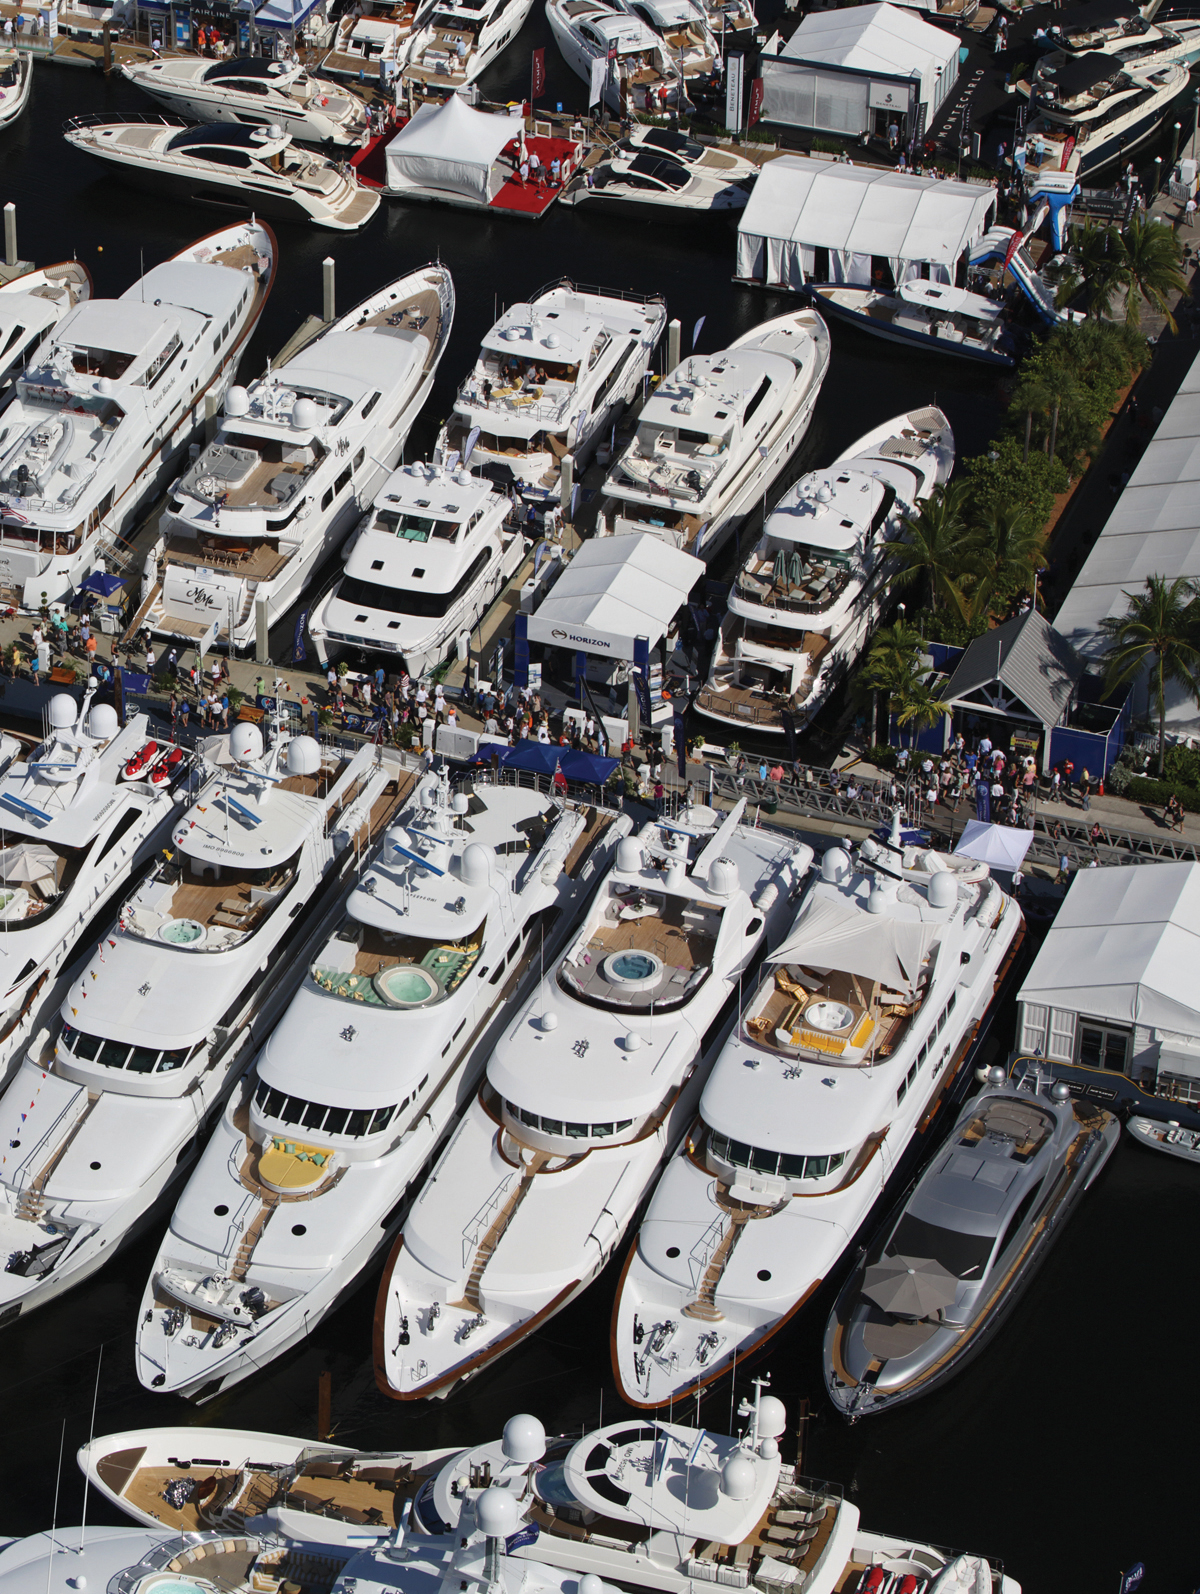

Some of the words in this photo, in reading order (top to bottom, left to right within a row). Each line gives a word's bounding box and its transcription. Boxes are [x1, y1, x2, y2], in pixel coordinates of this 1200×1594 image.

[189, 7, 231, 19] FAIRLINE
[875, 100, 902, 109] BENETEAU
[937, 69, 985, 138] MONTECARLO
[569, 634, 611, 648] HORIZON
